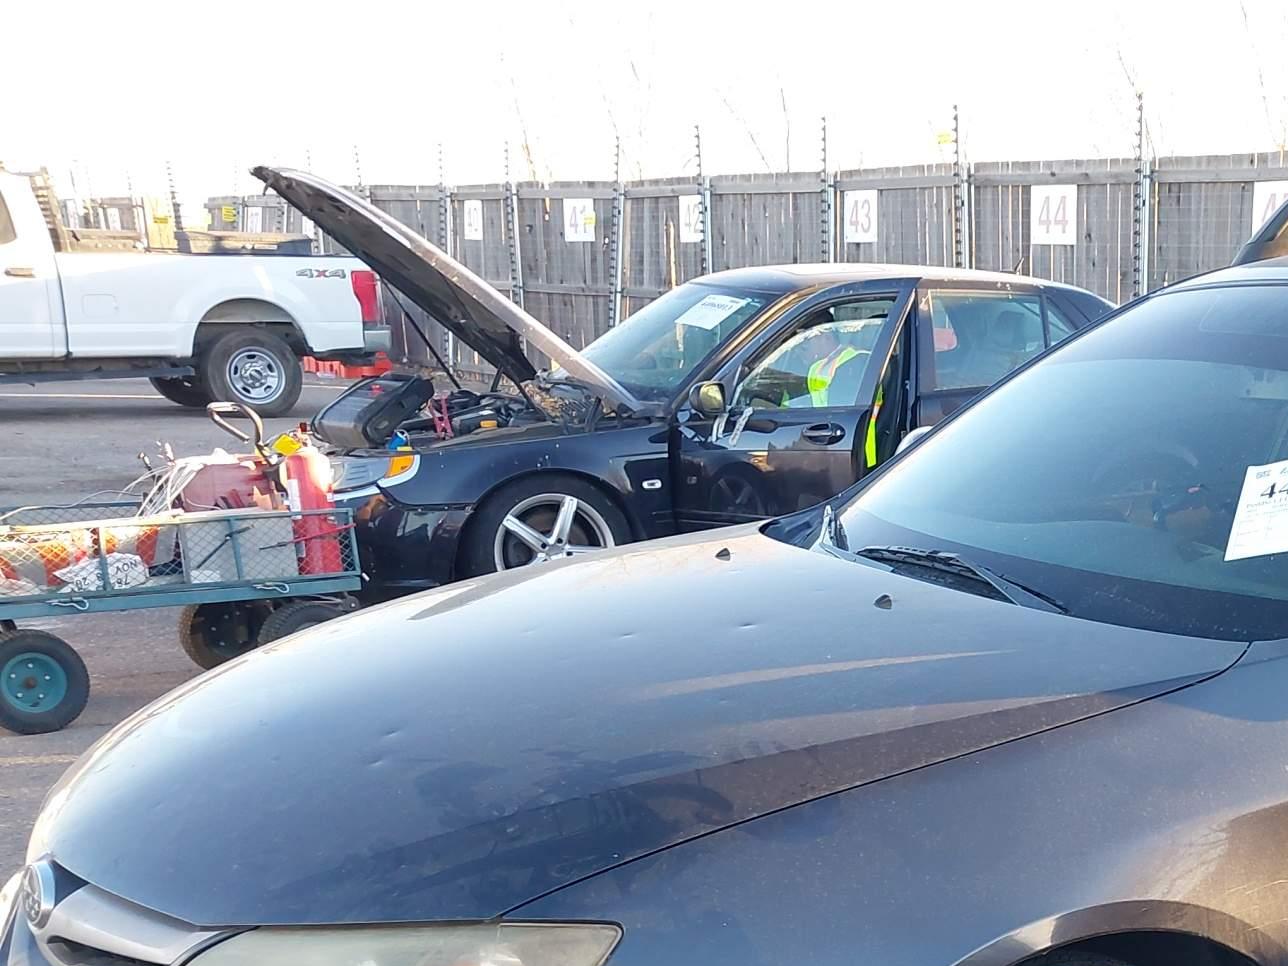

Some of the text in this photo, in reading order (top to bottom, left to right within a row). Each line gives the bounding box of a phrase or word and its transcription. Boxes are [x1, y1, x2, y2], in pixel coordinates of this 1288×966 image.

[683, 202, 702, 234] 42
[849, 198, 872, 234] 43
[1037, 195, 1069, 234] 44
